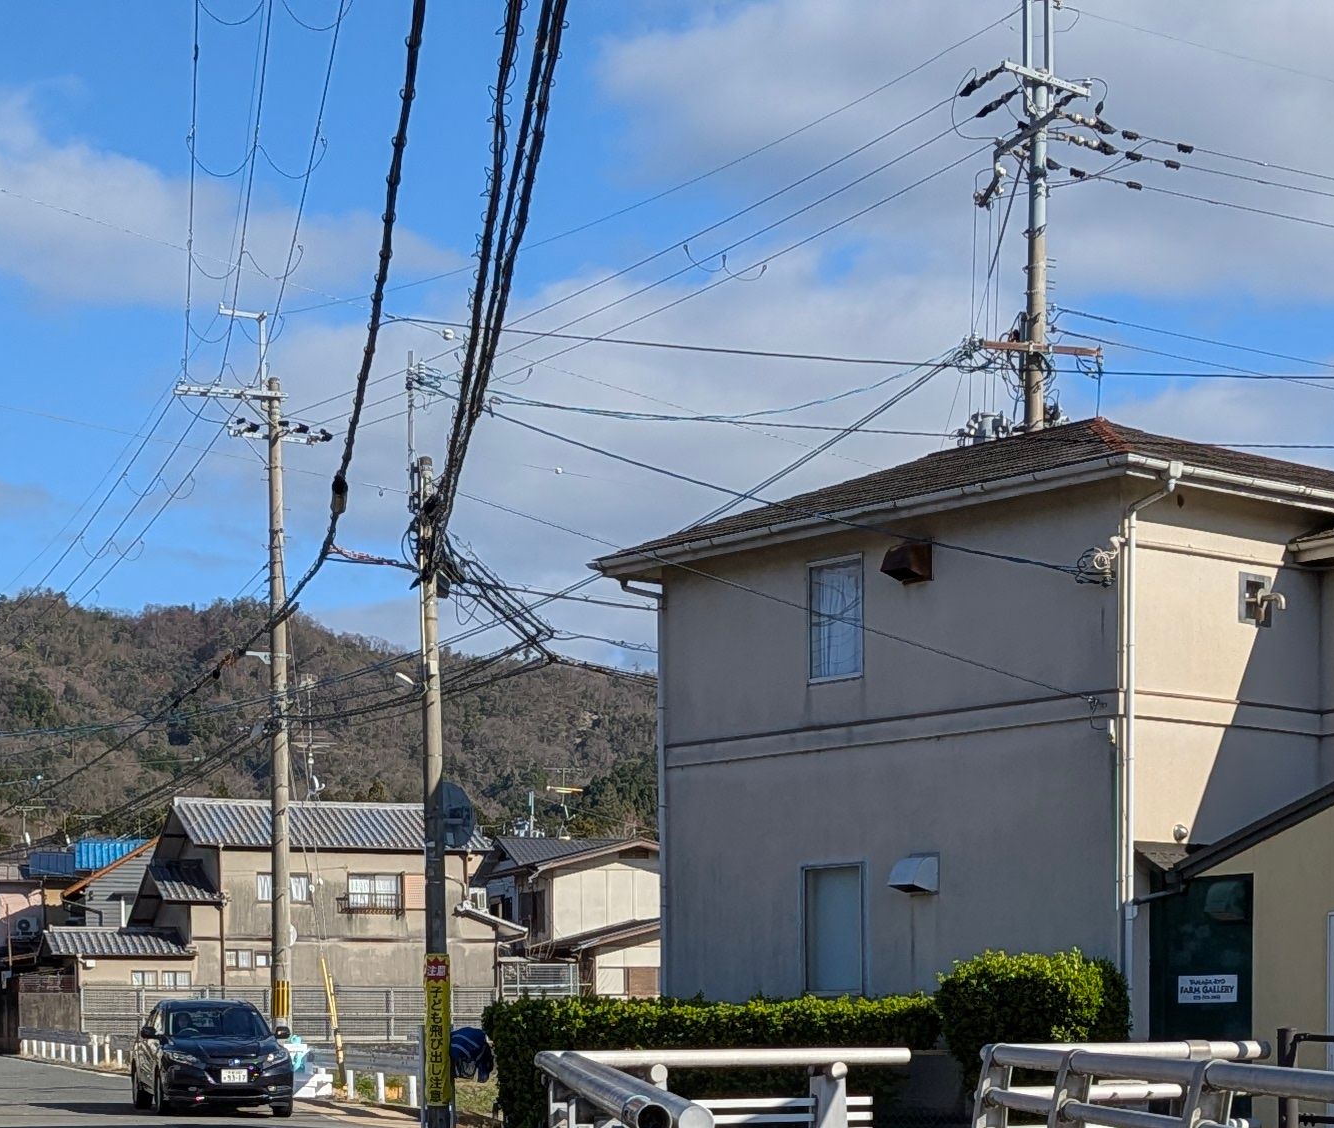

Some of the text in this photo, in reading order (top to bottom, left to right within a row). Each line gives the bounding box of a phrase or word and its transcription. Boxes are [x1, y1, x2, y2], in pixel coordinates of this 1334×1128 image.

[1202, 985, 1235, 994] GALLERY
[430, 986, 443, 1102] 子ども飛び出し注意
